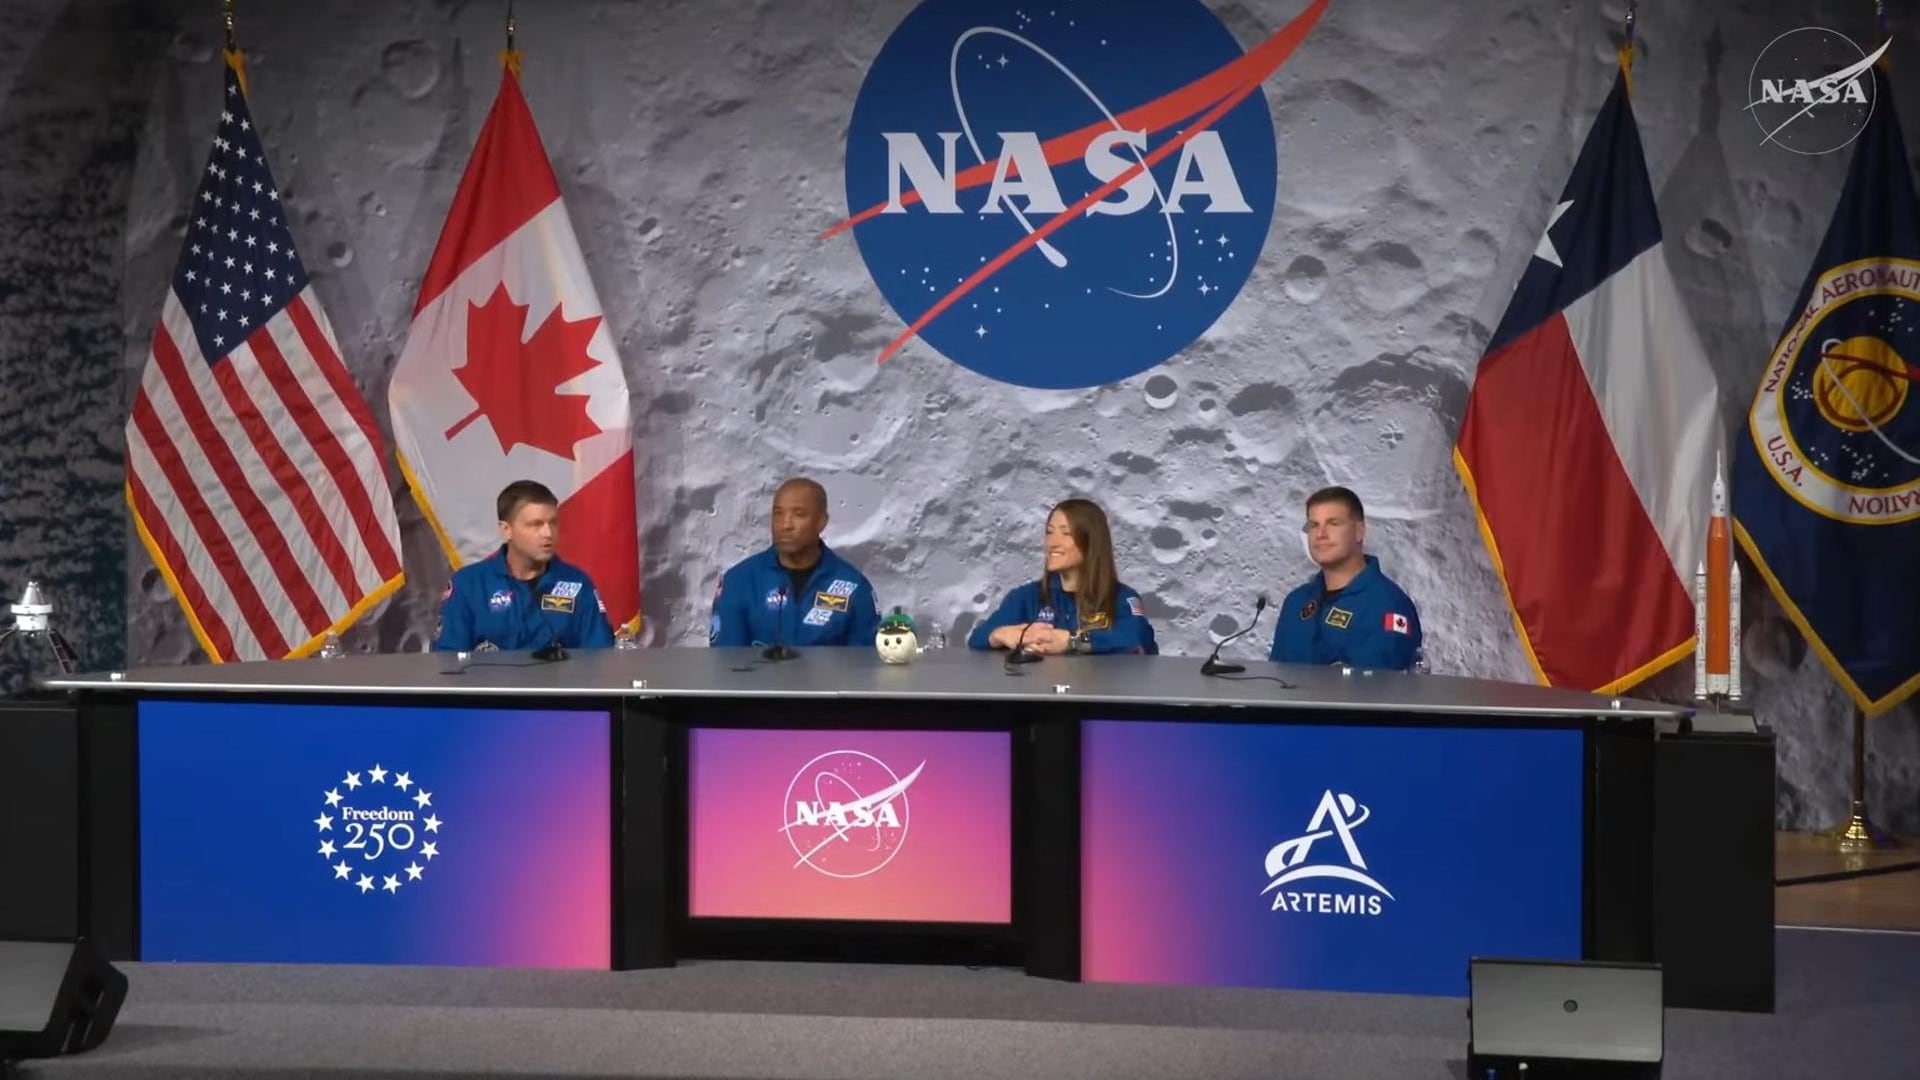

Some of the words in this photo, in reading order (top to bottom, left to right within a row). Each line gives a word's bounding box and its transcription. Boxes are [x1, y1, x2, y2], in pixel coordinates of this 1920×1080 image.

[881, 128, 1254, 218] NASA
[1767, 434, 1803, 488] U.S.A.
[342, 806, 415, 821] Freedom
[795, 801, 902, 828] NASA
[342, 821, 415, 861] 250
[1271, 891, 1383, 916] ARTEMIS
